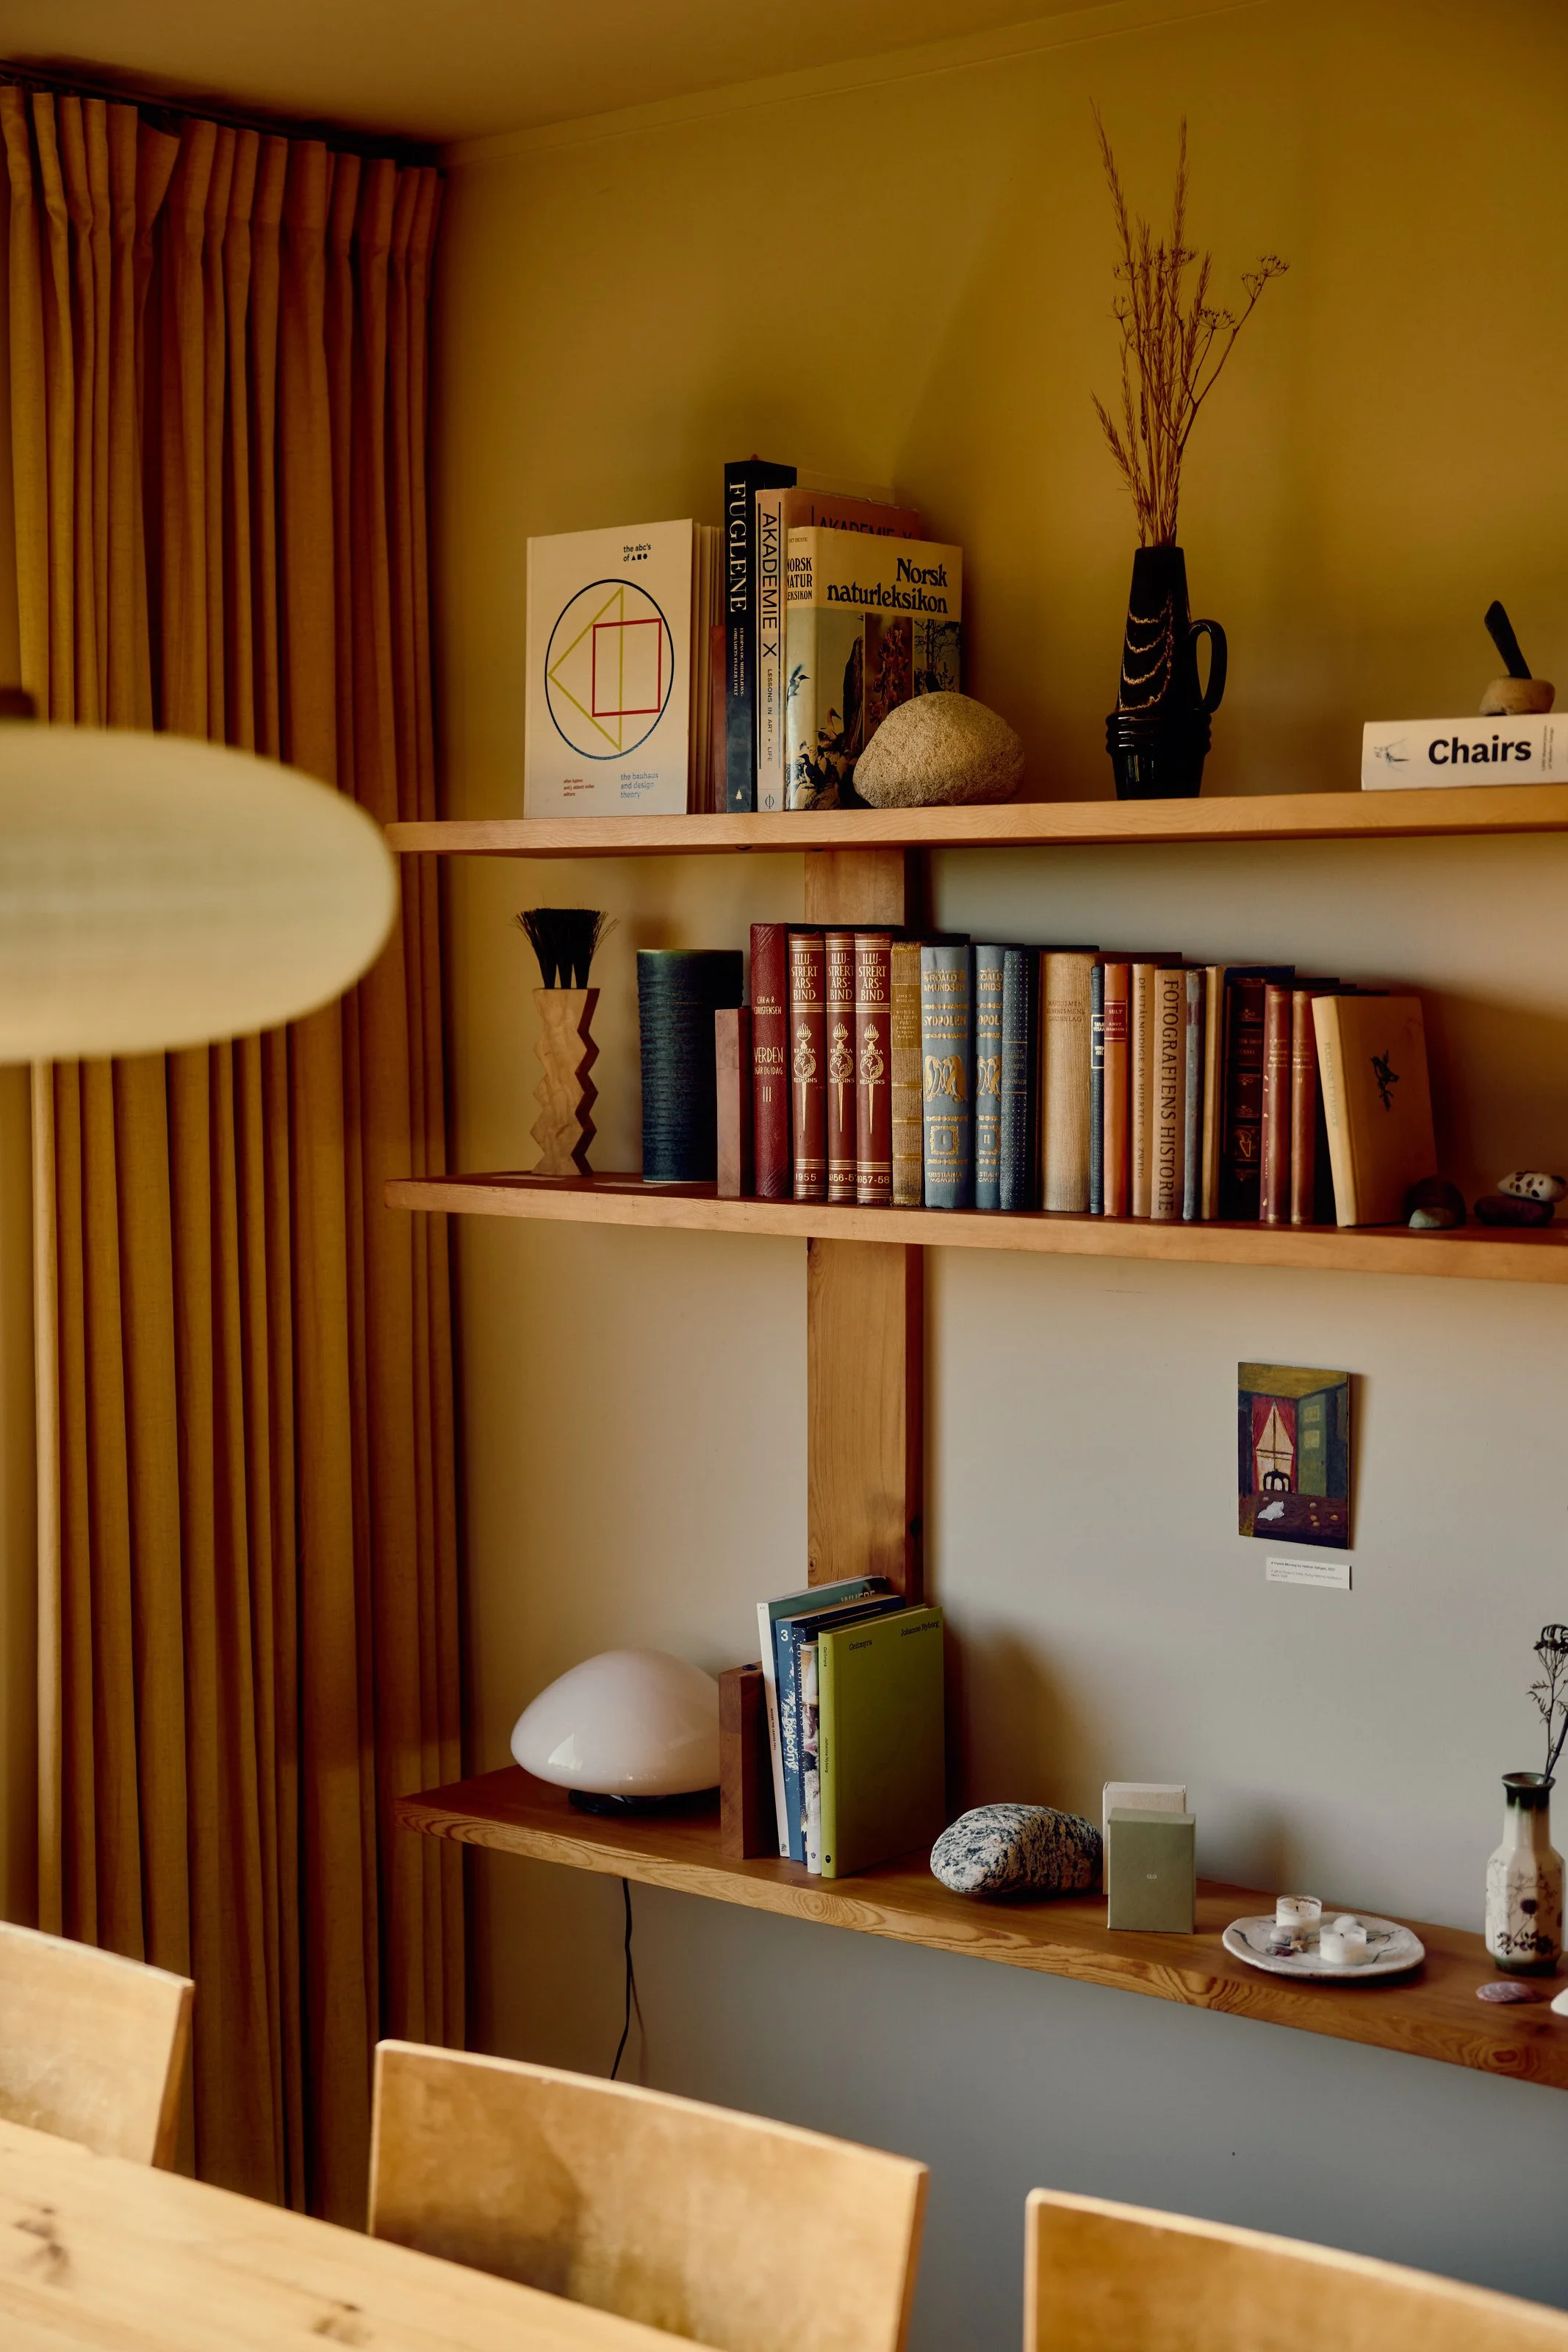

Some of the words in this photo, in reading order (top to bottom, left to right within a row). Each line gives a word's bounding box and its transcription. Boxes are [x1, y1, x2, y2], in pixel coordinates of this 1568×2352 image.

[635, 543, 652, 552] abc's
[729, 480, 747, 612] FUGLENE
[623, 553, 630, 562] of
[762, 512, 777, 629] AKADEMIE
[896, 557, 948, 587] Norsk
[787, 589, 813, 601] EKSIKON
[827, 581, 948, 614] naturleksikon
[762, 642, 777, 658] X
[1428, 734, 1532, 765] Chairs
[632, 772, 659, 780] bauhaus
[633, 781, 655, 790] design
[620, 791, 641, 800] theory
[794, 953, 813, 965] ILLU-
[831, 953, 850, 964] ILLU-
[863, 953, 882, 965] ILLU-
[791, 966, 819, 977] STRERT
[828, 965, 855, 977] STRERT
[858, 966, 887, 977] STRERT
[979, 973, 1003, 981] OALD
[794, 977, 814, 989] ÅRS-
[831, 976, 851, 989] ÅRS-
[862, 977, 882, 989] ÅRS-
[929, 974, 957, 982] ROALD
[1138, 977, 1146, 991] DE
[924, 983, 965, 992] AMUNDSEN
[794, 989, 816, 1000] BIND
[830, 989, 853, 1000] BIND
[860, 989, 885, 1001] BIND
[923, 1016, 967, 1027] SYDPOLEN
[1137, 994, 1148, 1063] UTÅLMODIGE
[754, 1047, 783, 1064] VERDEN
[1161, 979, 1179, 1120] FOTOGRAFIENS
[1137, 1066, 1146, 1080] AV
[763, 1086, 772, 1102] III
[1137, 1083, 1146, 1127] HJERTET
[983, 1134, 990, 1144] II
[1137, 1147, 1146, 1179] ZWEIG
[1157, 1125, 1176, 1211] HISTORIE
[796, 1173, 816, 1181] 1955
[900, 1627, 921, 1637] Johanne
[921, 1620, 940, 1632] Nyborg
[780, 1629, 789, 1642] 3
[848, 1639, 873, 1651] Geitmyra
[784, 1717, 799, 1770] balcony
